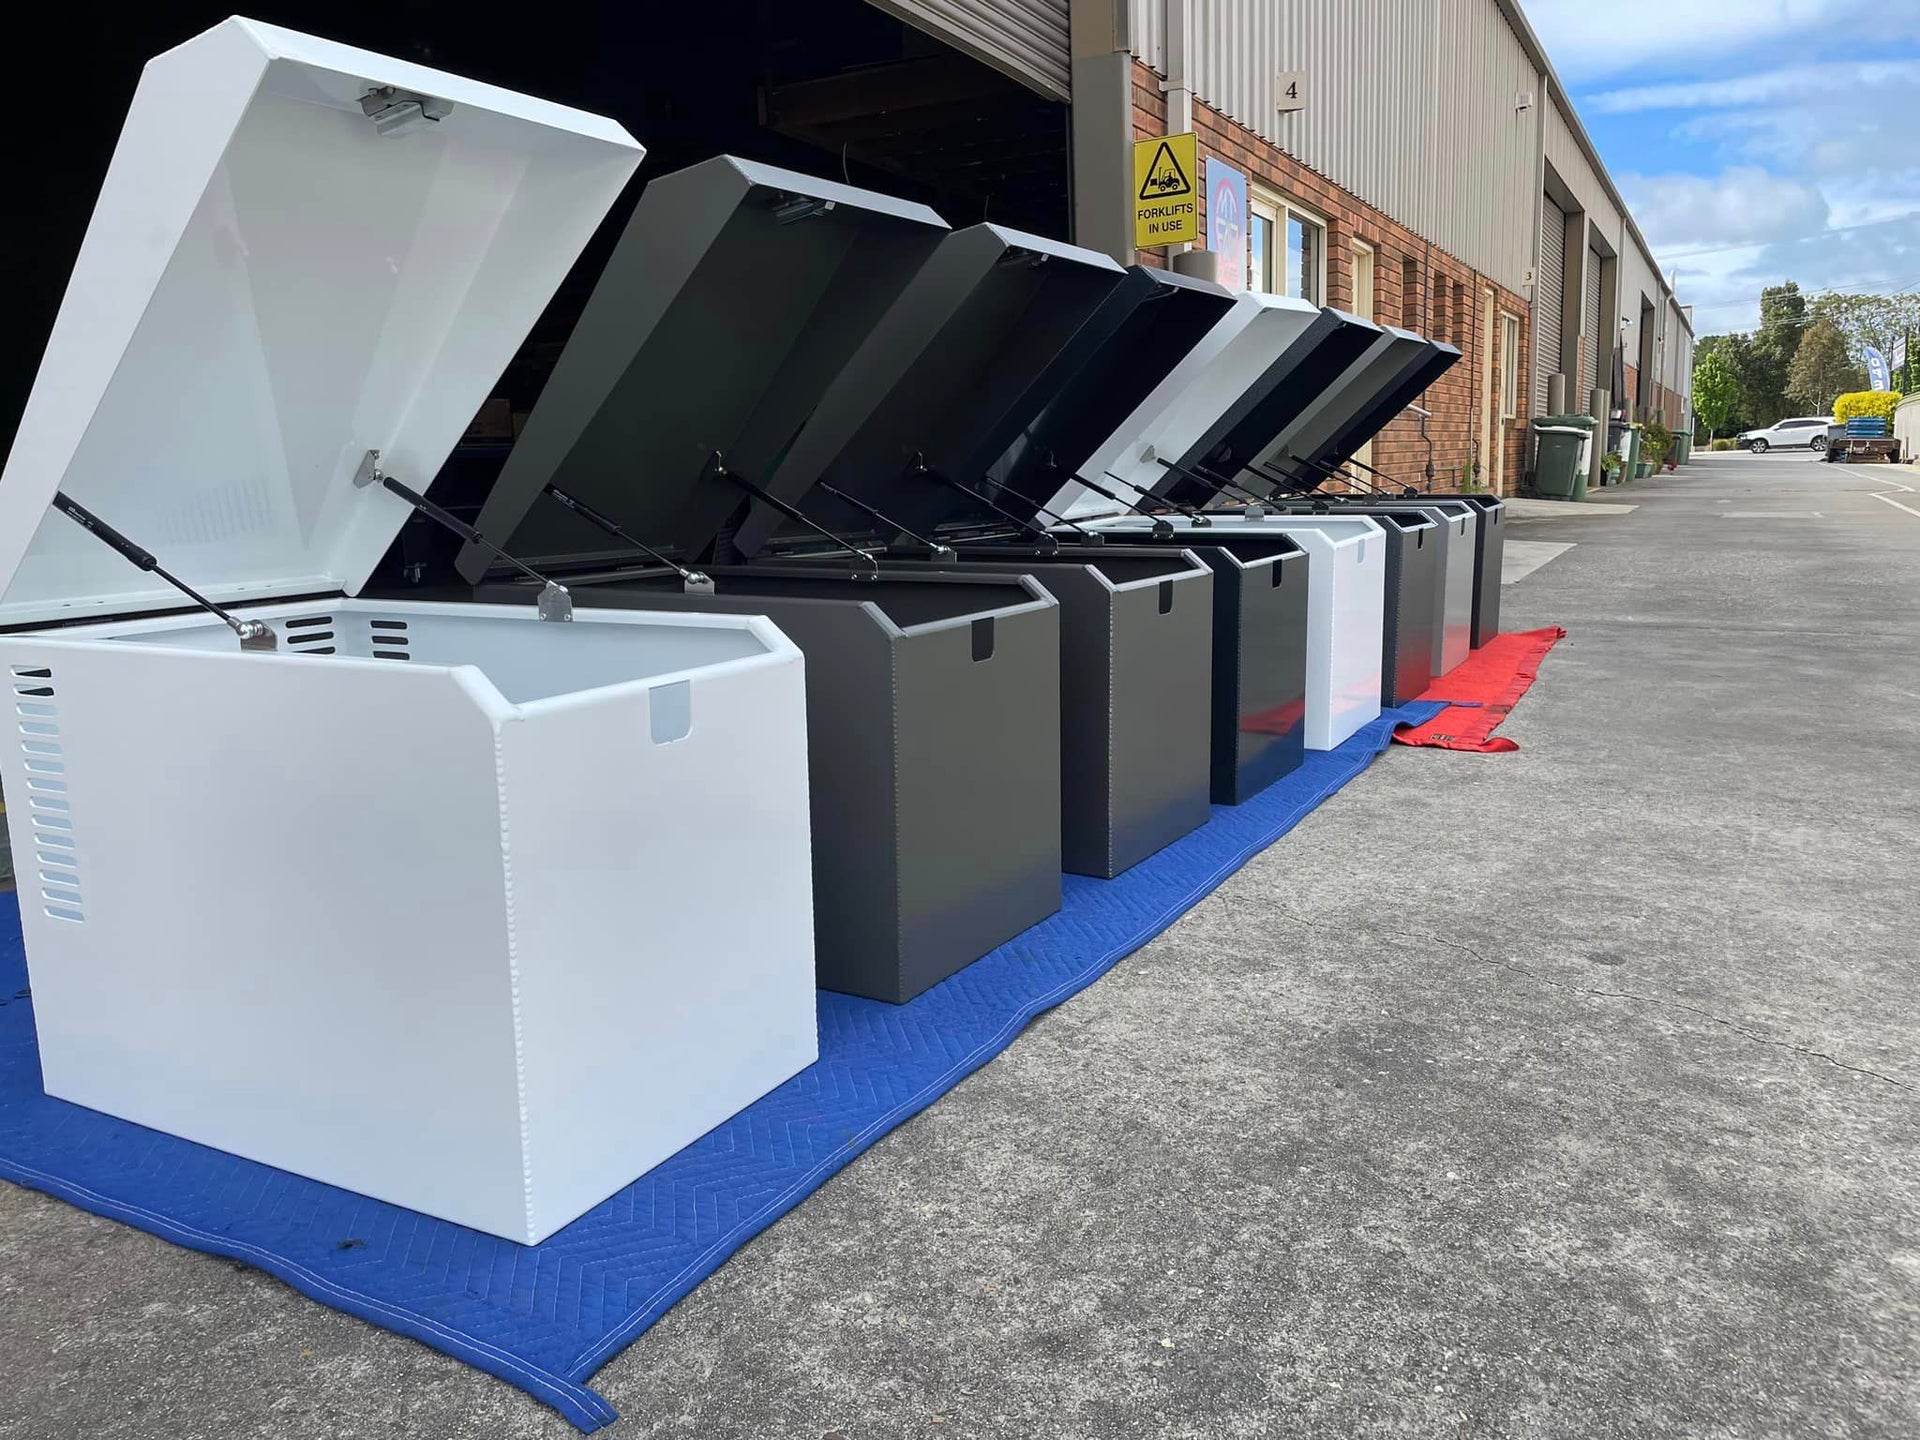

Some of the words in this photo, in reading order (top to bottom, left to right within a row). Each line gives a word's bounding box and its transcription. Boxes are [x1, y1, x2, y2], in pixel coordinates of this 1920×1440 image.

[1285, 81, 1298, 99] 4
[1137, 203, 1193, 220] FORKLIFTS
[1149, 223, 1159, 234] IN
[1162, 220, 1182, 232] USE
[1525, 271, 1532, 281] 3
